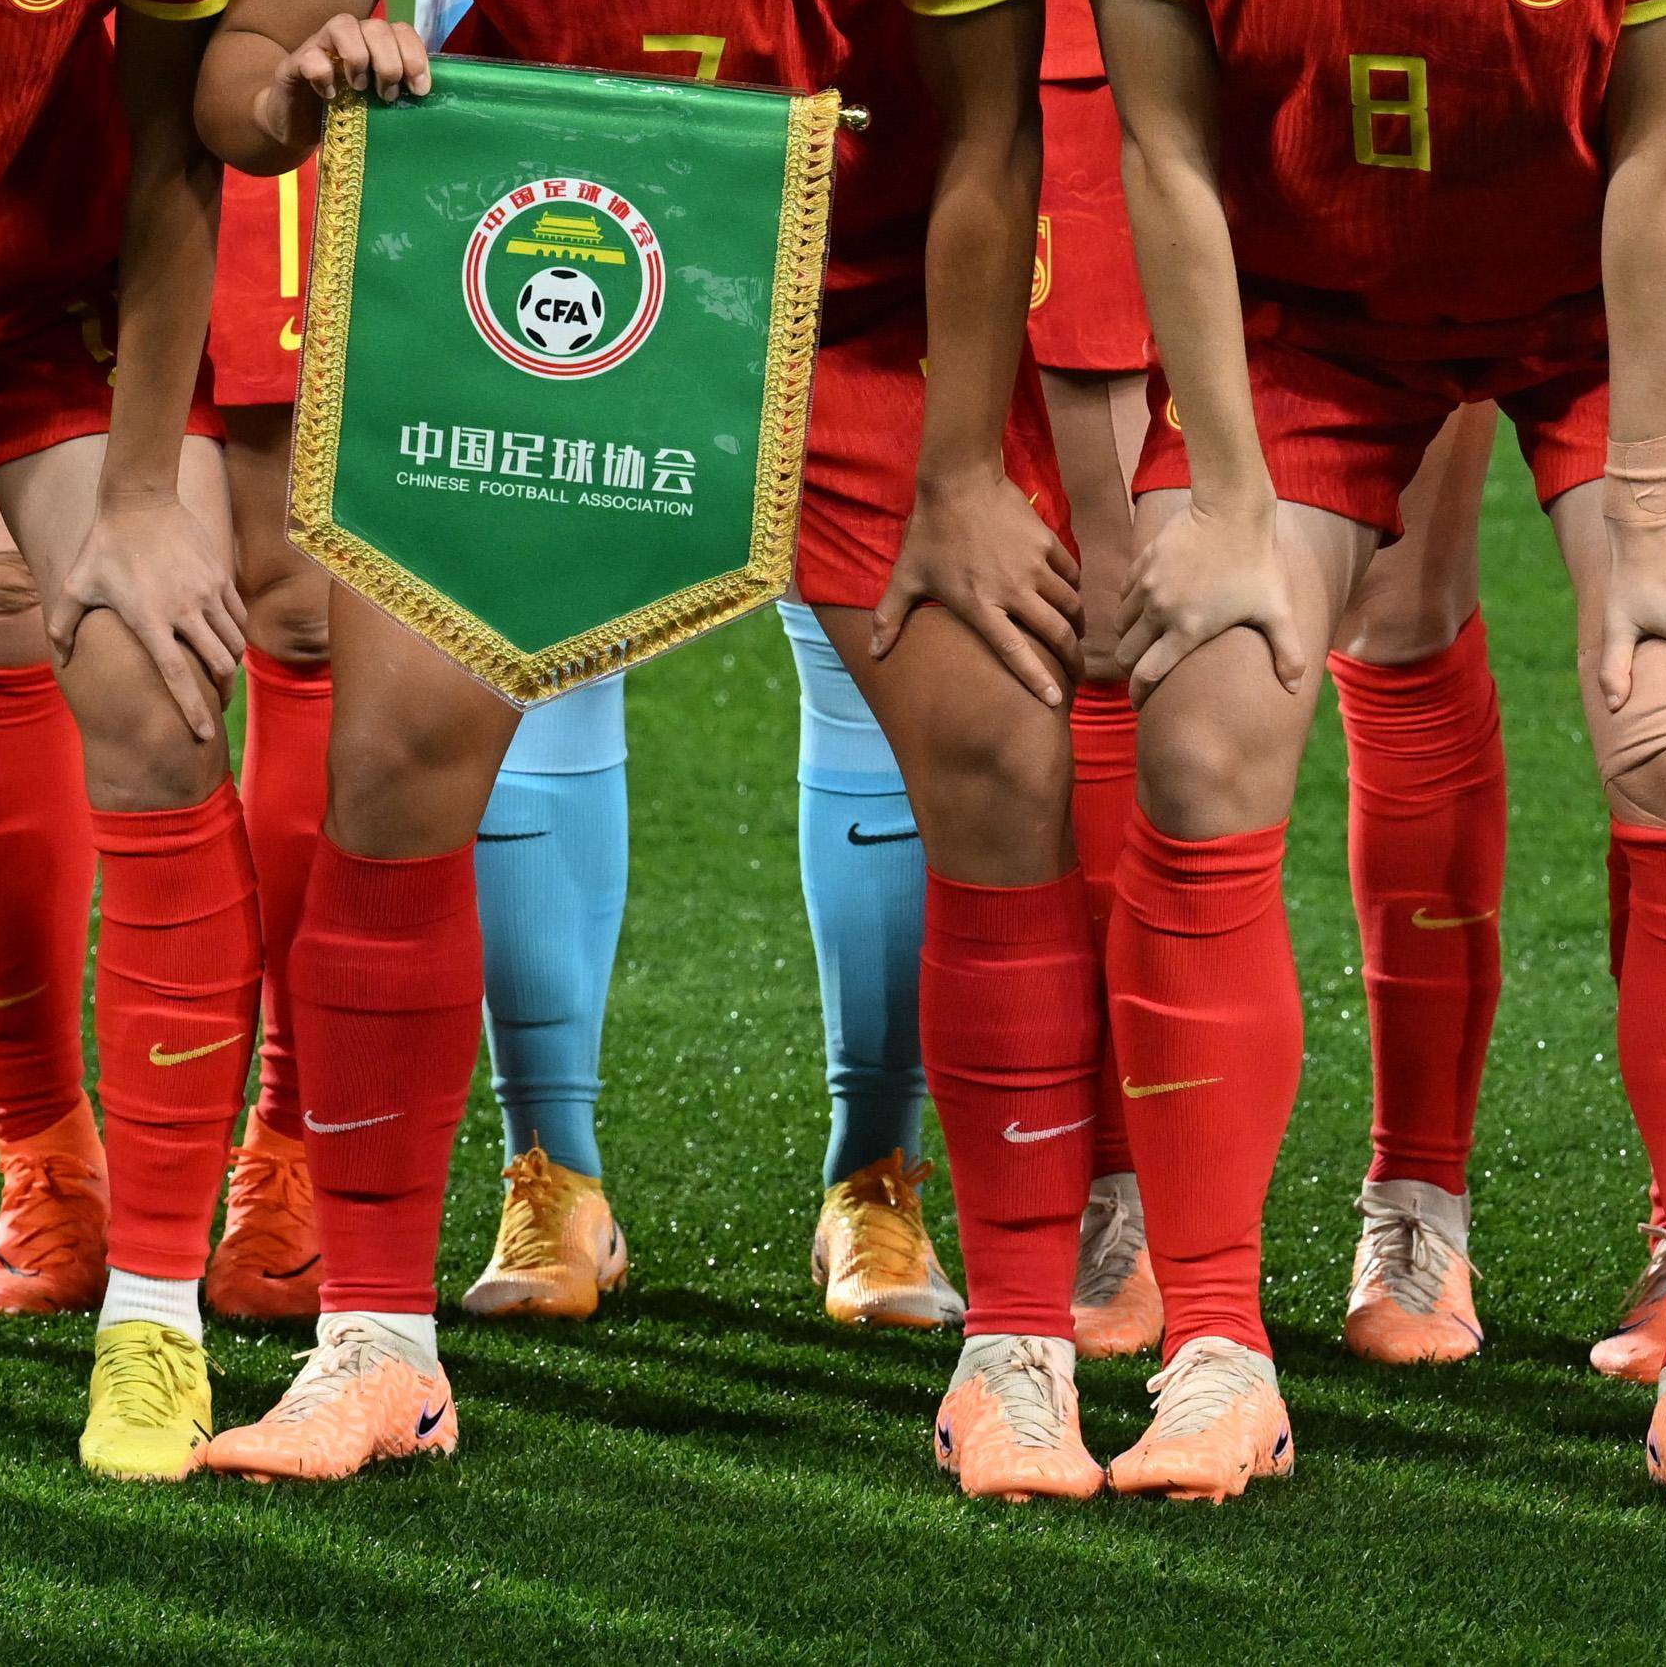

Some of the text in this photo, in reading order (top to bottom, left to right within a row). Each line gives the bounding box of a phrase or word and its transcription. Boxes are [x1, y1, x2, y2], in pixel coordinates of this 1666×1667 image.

[1348, 53, 1432, 172] 8
[483, 179, 654, 248] 中国足球协会
[534, 297, 588, 326] CFA
[399, 421, 697, 495] 中国足球协会
[395, 471, 694, 517] CHINESE FOOTBALL ASSOCIATION
